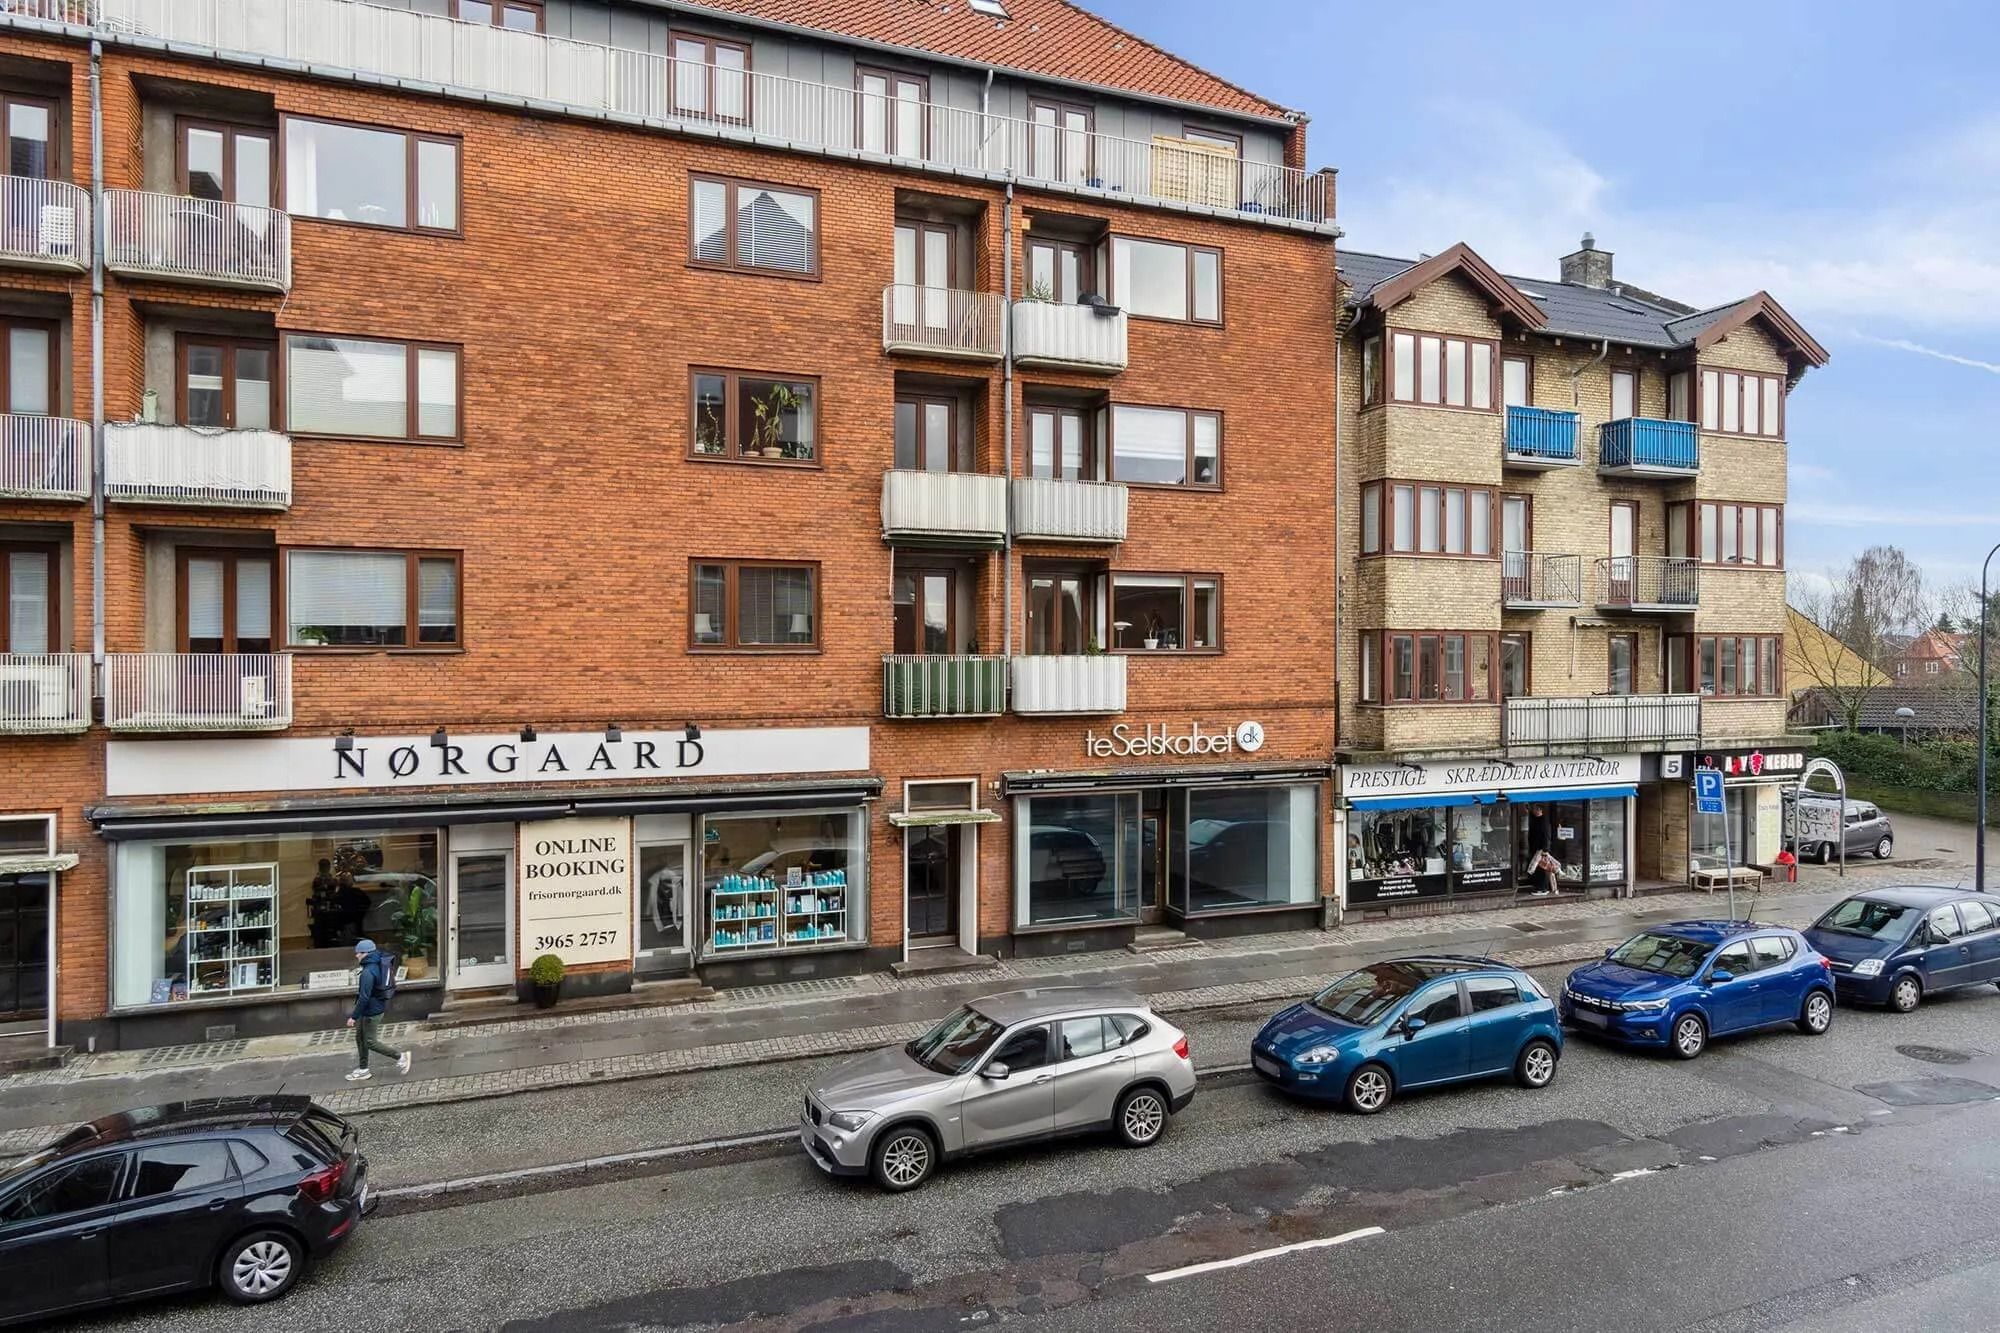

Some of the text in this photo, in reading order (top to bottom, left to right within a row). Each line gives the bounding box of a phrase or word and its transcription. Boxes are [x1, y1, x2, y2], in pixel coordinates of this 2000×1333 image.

[1085, 721, 1235, 757] teSelskabet
[334, 740, 704, 780] NØRGAARD
[1667, 760, 1680, 774] 5
[1765, 753, 1803, 770] KEBAB
[1349, 768, 1428, 789] PRESTIGE
[1702, 776, 1716, 795] P
[535, 837, 617, 857] ONLINE
[526, 858, 625, 880] BOOKING
[528, 886, 622, 901] frisornorgaard.dk
[535, 930, 617, 951] 3965 2757
